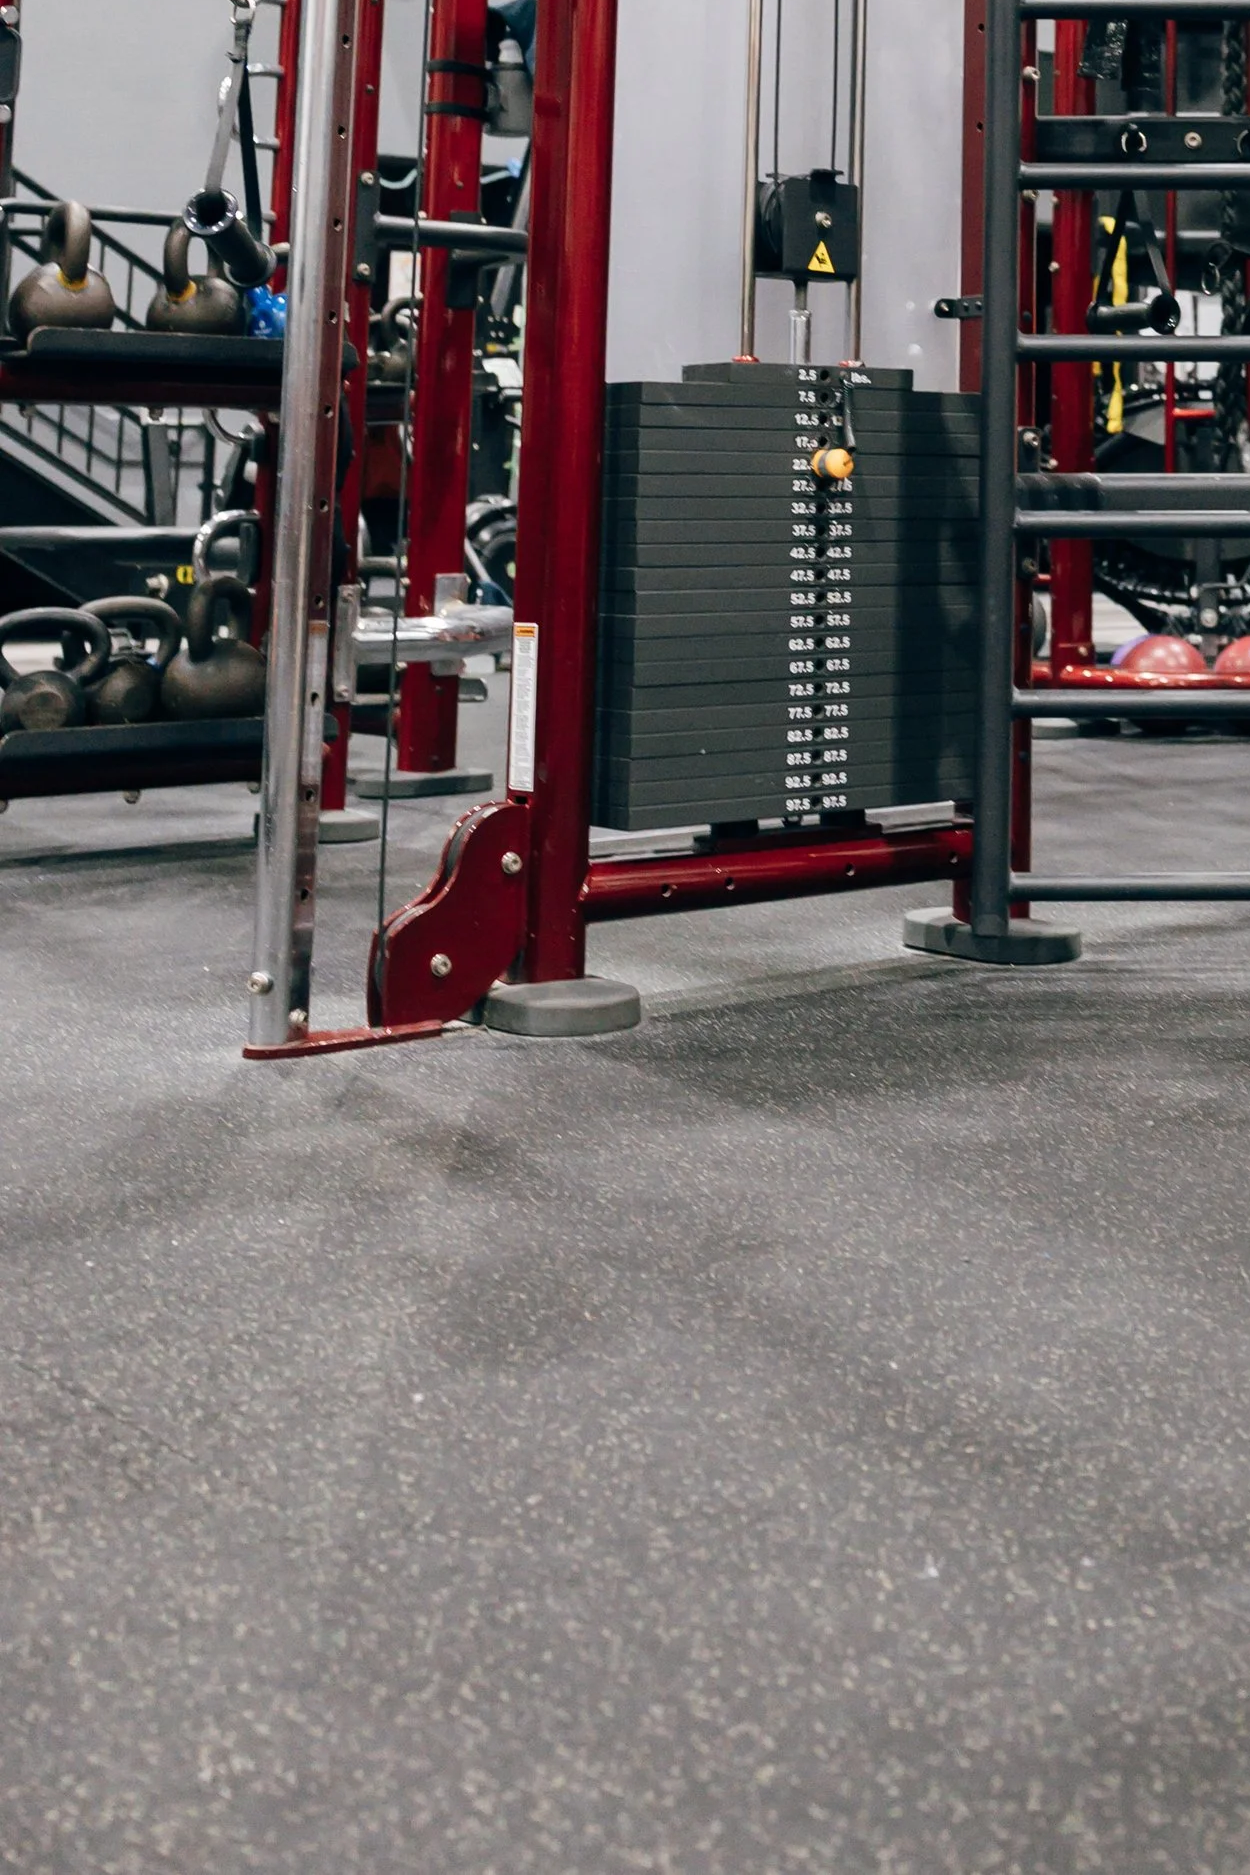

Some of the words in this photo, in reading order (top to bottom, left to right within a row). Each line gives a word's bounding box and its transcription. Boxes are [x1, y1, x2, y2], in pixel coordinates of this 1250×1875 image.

[798, 369, 817, 381] 2.5
[798, 391, 816, 403] 7.5
[795, 414, 819, 426] 12.5
[791, 502, 816, 515] 32.5
[828, 502, 853, 515] 32.5
[791, 525, 816, 537] 37.5
[828, 524, 853, 537] 37.5
[790, 547, 816, 559] 42.5
[826, 546, 852, 559] 42.5
[790, 569, 815, 582] 47.5
[827, 568, 851, 581] 47.5
[790, 592, 816, 605] 52.5
[827, 591, 852, 604] 52.5
[790, 615, 815, 628] 57.5
[827, 614, 851, 627] 57.5
[789, 637, 815, 651] 62.5
[825, 636, 851, 649] 62.5
[789, 660, 815, 674] 67.5
[826, 658, 851, 672] 67.5
[788, 683, 815, 697] 72.5
[825, 681, 851, 695] 72.5
[787, 706, 813, 720] 77.5
[824, 704, 849, 717] 77.5
[787, 729, 813, 743] 82.5
[823, 726, 849, 740] 82.5
[786, 752, 812, 766] 87.5
[823, 749, 848, 763] 87.5
[785, 775, 811, 789] 92.5
[821, 772, 848, 786] 92.5
[785, 798, 811, 812] 97.5
[822, 795, 847, 809] 97.5
